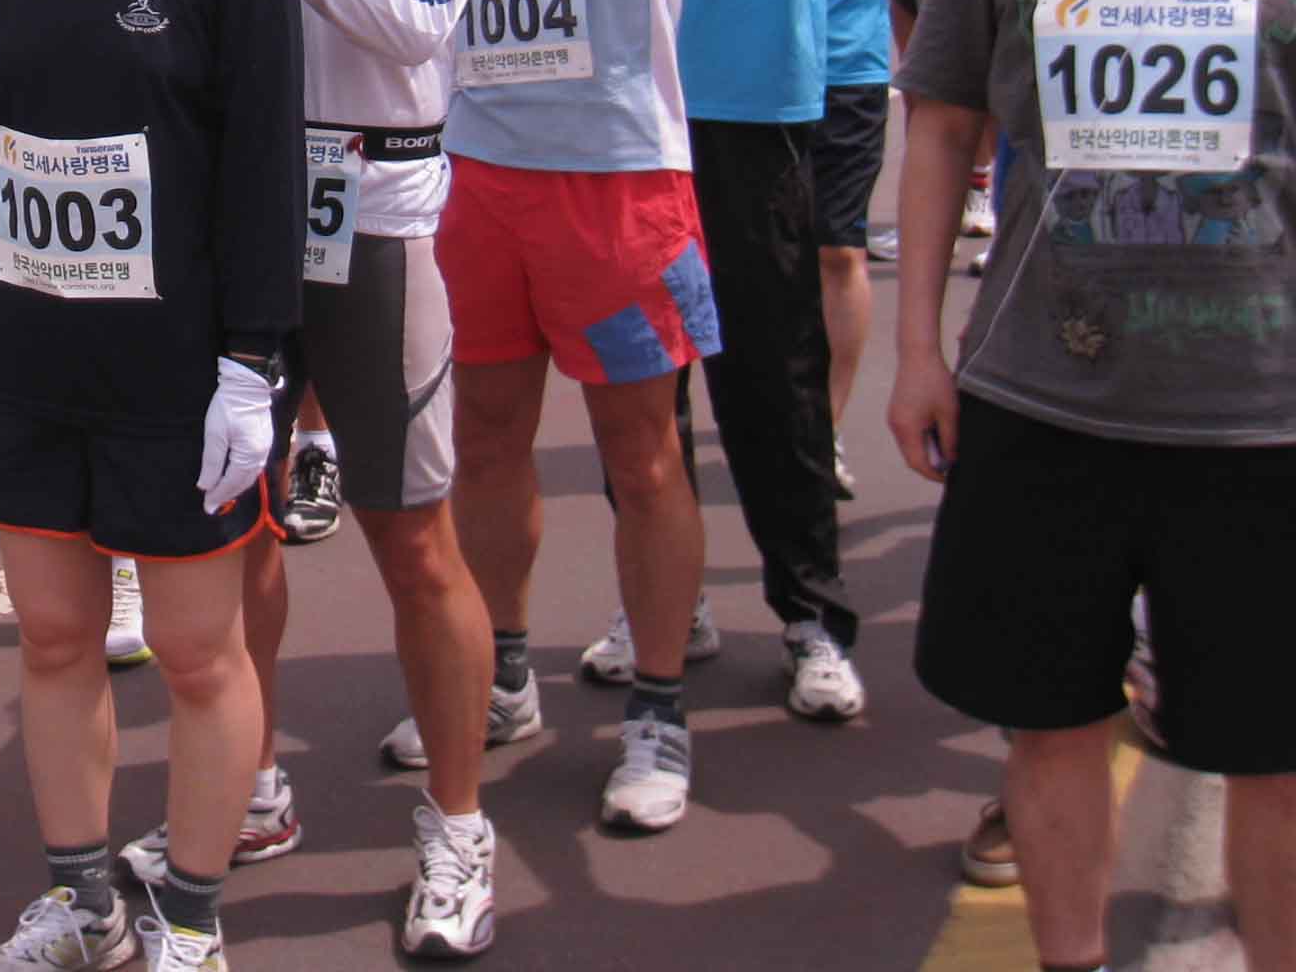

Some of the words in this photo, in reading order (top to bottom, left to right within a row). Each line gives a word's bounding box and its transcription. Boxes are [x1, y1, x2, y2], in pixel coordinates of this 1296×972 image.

[1099, 5, 1235, 28] 연세사랑병원
[1049, 43, 1240, 116] 1026
[1069, 129, 1221, 152] 한국산악마라톤연맹
[22, 150, 130, 176] 연세사랑병원
[1, 178, 143, 252] 1003
[307, 177, 346, 237] 5
[12, 251, 130, 281] 한국산악마라톤연맹
